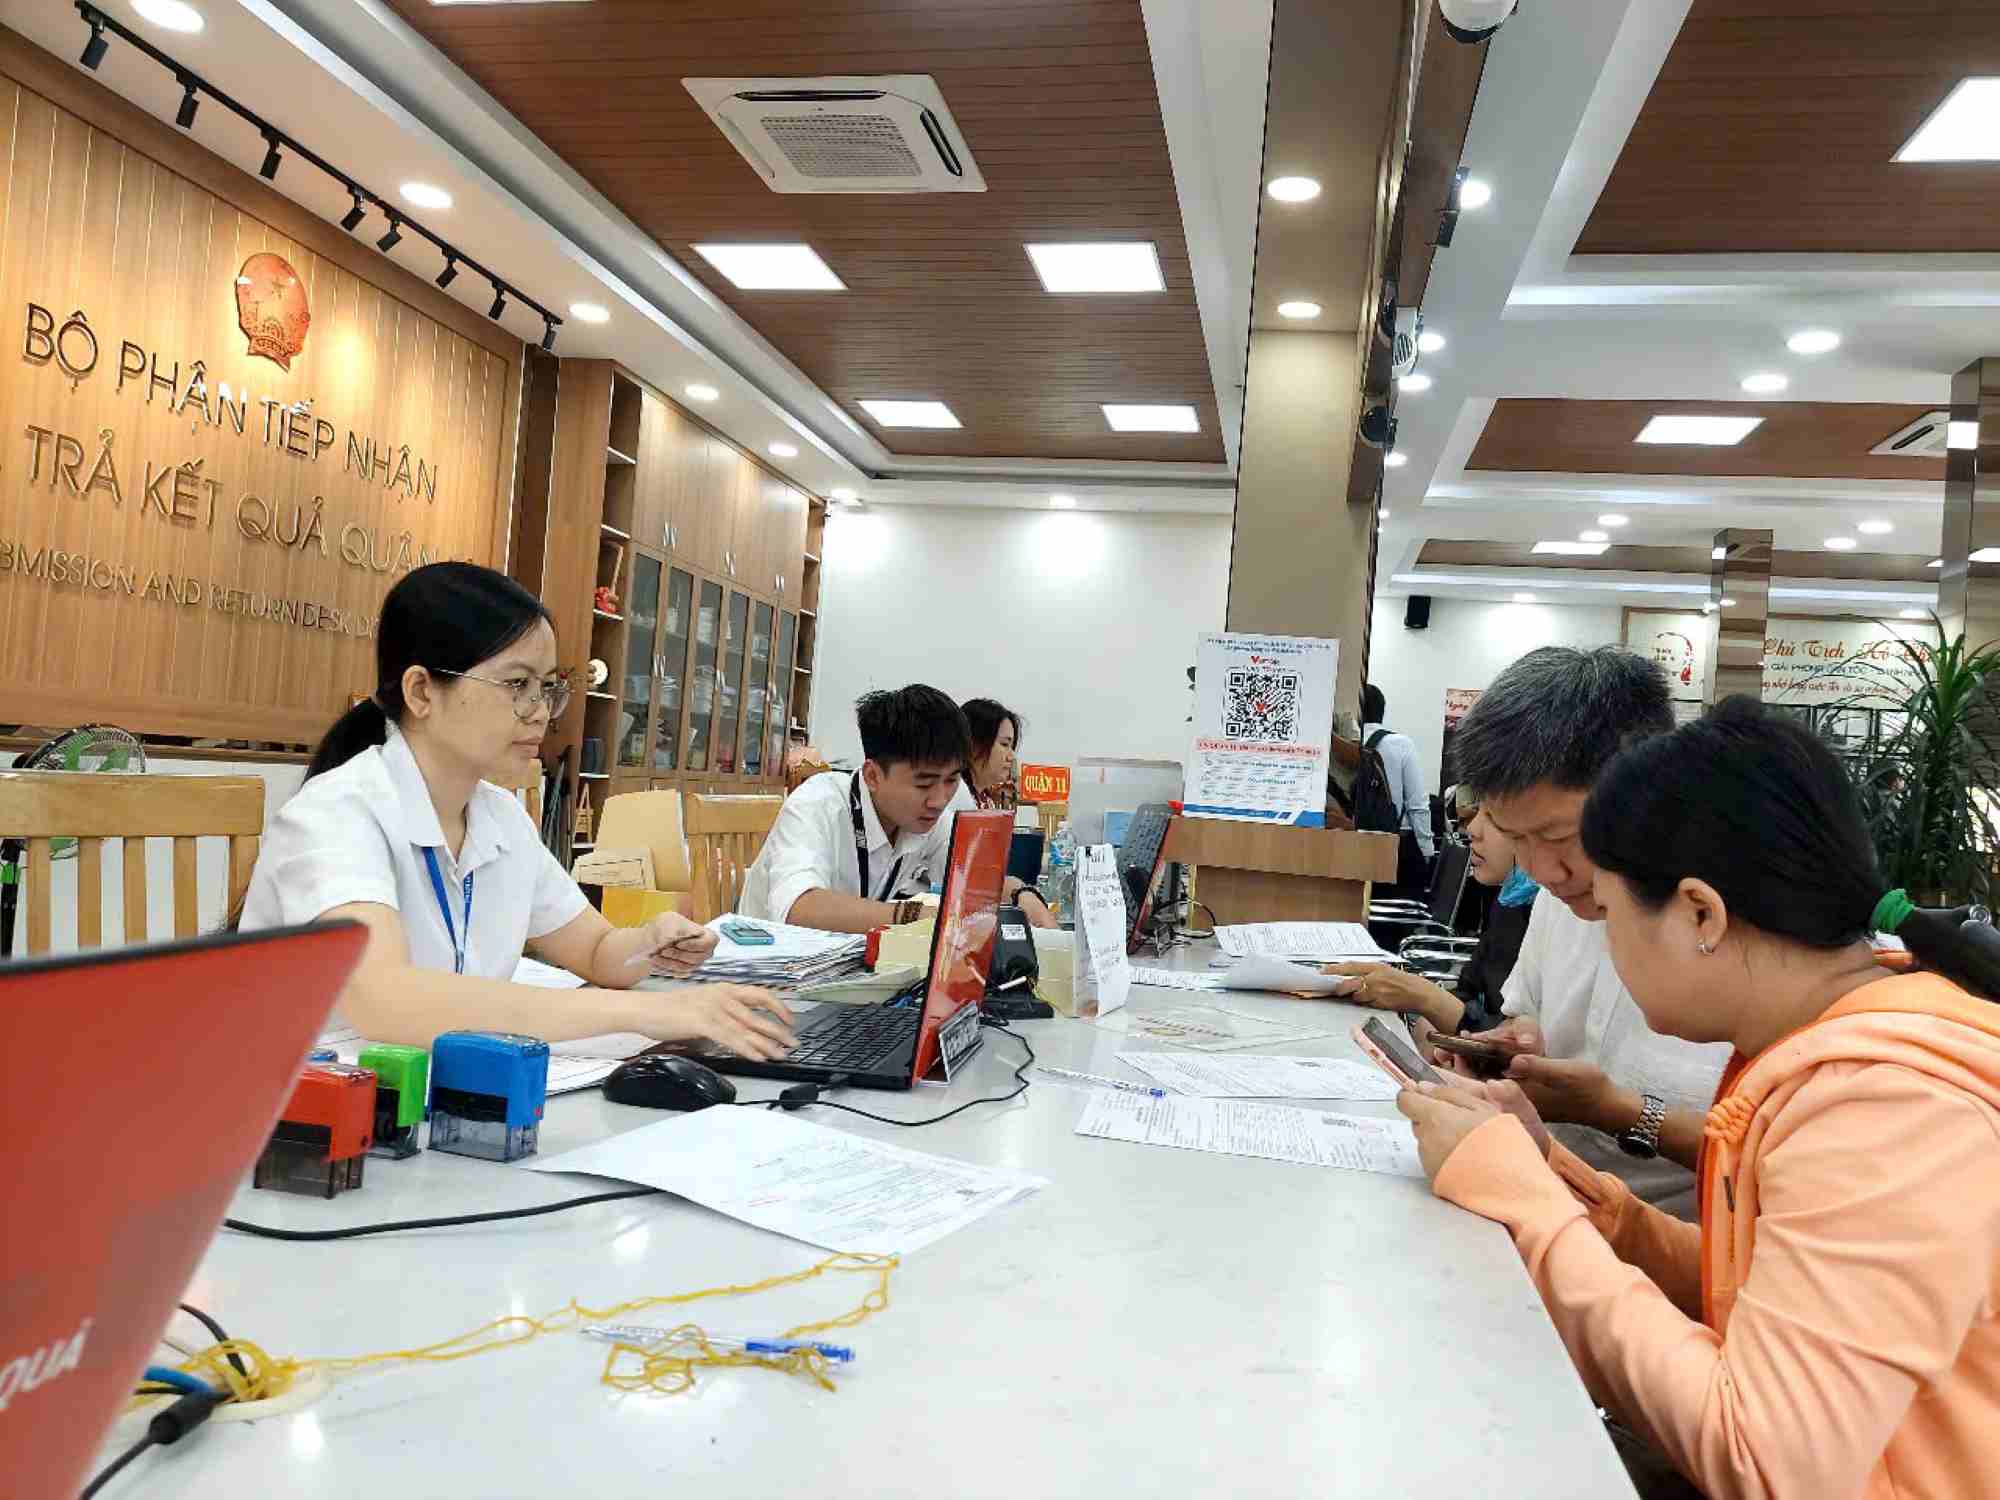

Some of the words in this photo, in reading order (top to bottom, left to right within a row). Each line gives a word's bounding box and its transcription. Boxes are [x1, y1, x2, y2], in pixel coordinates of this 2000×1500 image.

[23, 302, 99, 395] BỘ
[116, 339, 247, 435] PHẬN
[258, 397, 336, 462] TIẾP
[344, 430, 438, 504] NHẬN
[24, 424, 122, 505] TRẢ
[140, 458, 224, 531] KẾT
[236, 494, 328, 556] QUẢ
[138, 569, 202, 607] AND
[207, 582, 299, 628] RETURN
[302, 601, 352, 637] DESK
